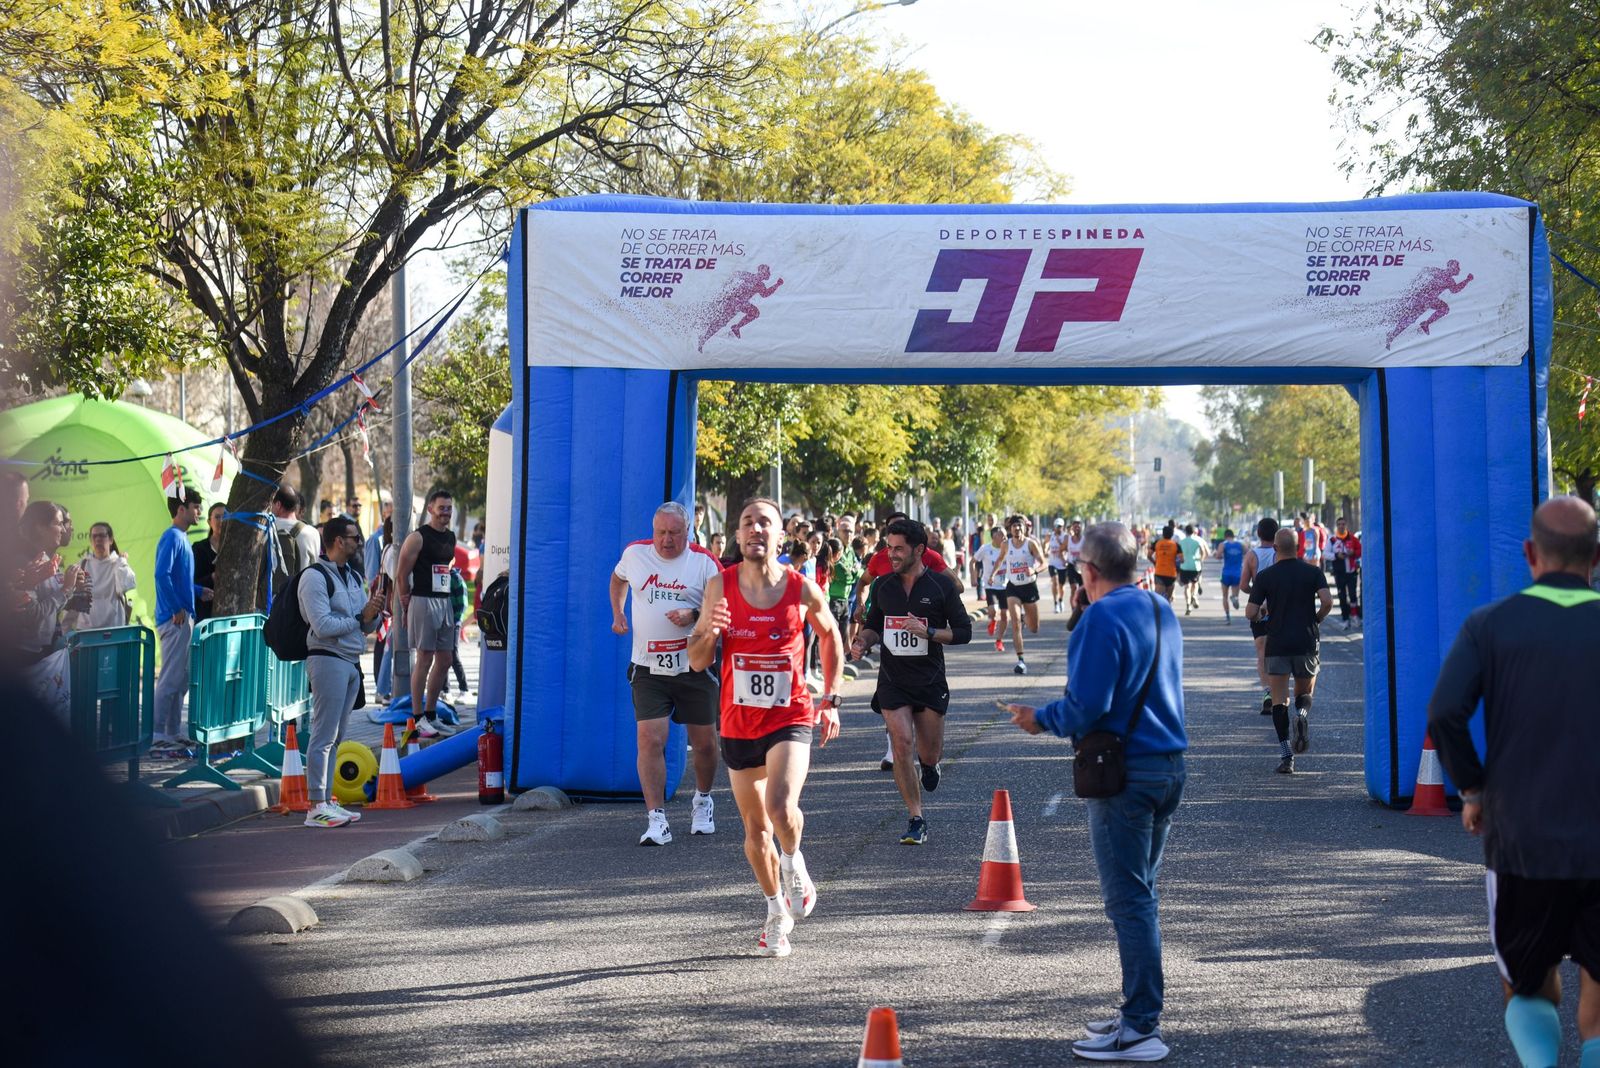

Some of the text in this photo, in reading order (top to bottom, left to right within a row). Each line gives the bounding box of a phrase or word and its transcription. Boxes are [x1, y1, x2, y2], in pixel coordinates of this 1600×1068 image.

[621, 228, 717, 241] NO SE TRATA
[1305, 225, 1404, 239] NO SE TRATA
[620, 241, 746, 257] DE CORRER MÁS,
[1306, 236, 1435, 253] DE CORRER MÁS,
[620, 257, 717, 270] SE TRATA DE
[1306, 254, 1405, 267] SE TRATA DE
[620, 271, 683, 284] CORRER
[1306, 269, 1371, 282] CORRER
[620, 286, 674, 299] MEJOR
[1306, 284, 1362, 297] MEJOR
[892, 631, 919, 648] 186
[656, 652, 681, 669] 231
[750, 673, 775, 697] 88
